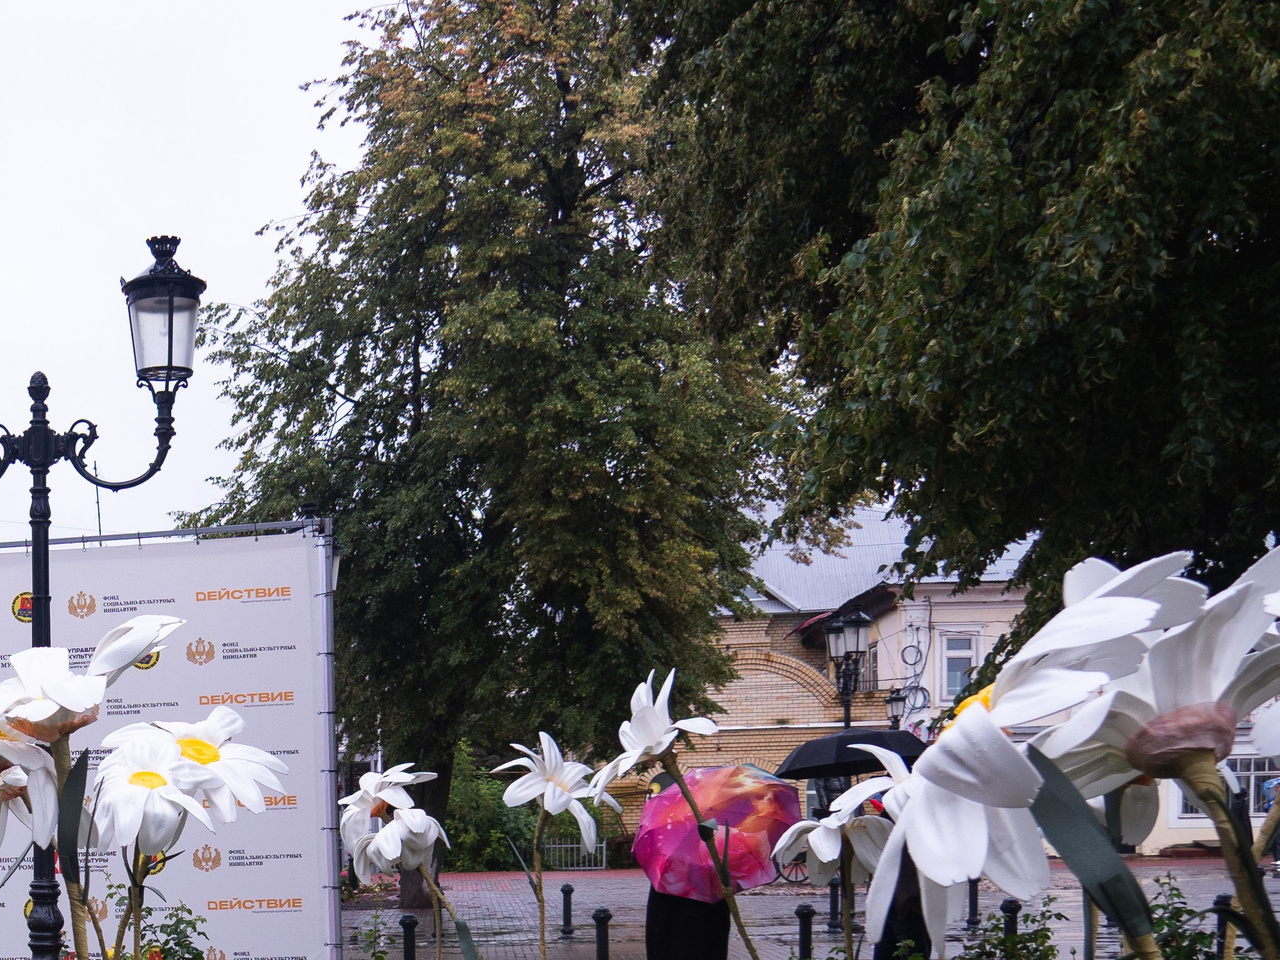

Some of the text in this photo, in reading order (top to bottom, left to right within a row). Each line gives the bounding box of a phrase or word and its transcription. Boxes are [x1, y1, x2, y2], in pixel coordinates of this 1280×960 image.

[195, 586, 291, 602] ДЕЙСТВИЕ
[199, 691, 294, 706] ДЕЙСТВИЕ
[207, 897, 302, 911] ДЕЙСТВИЕ
